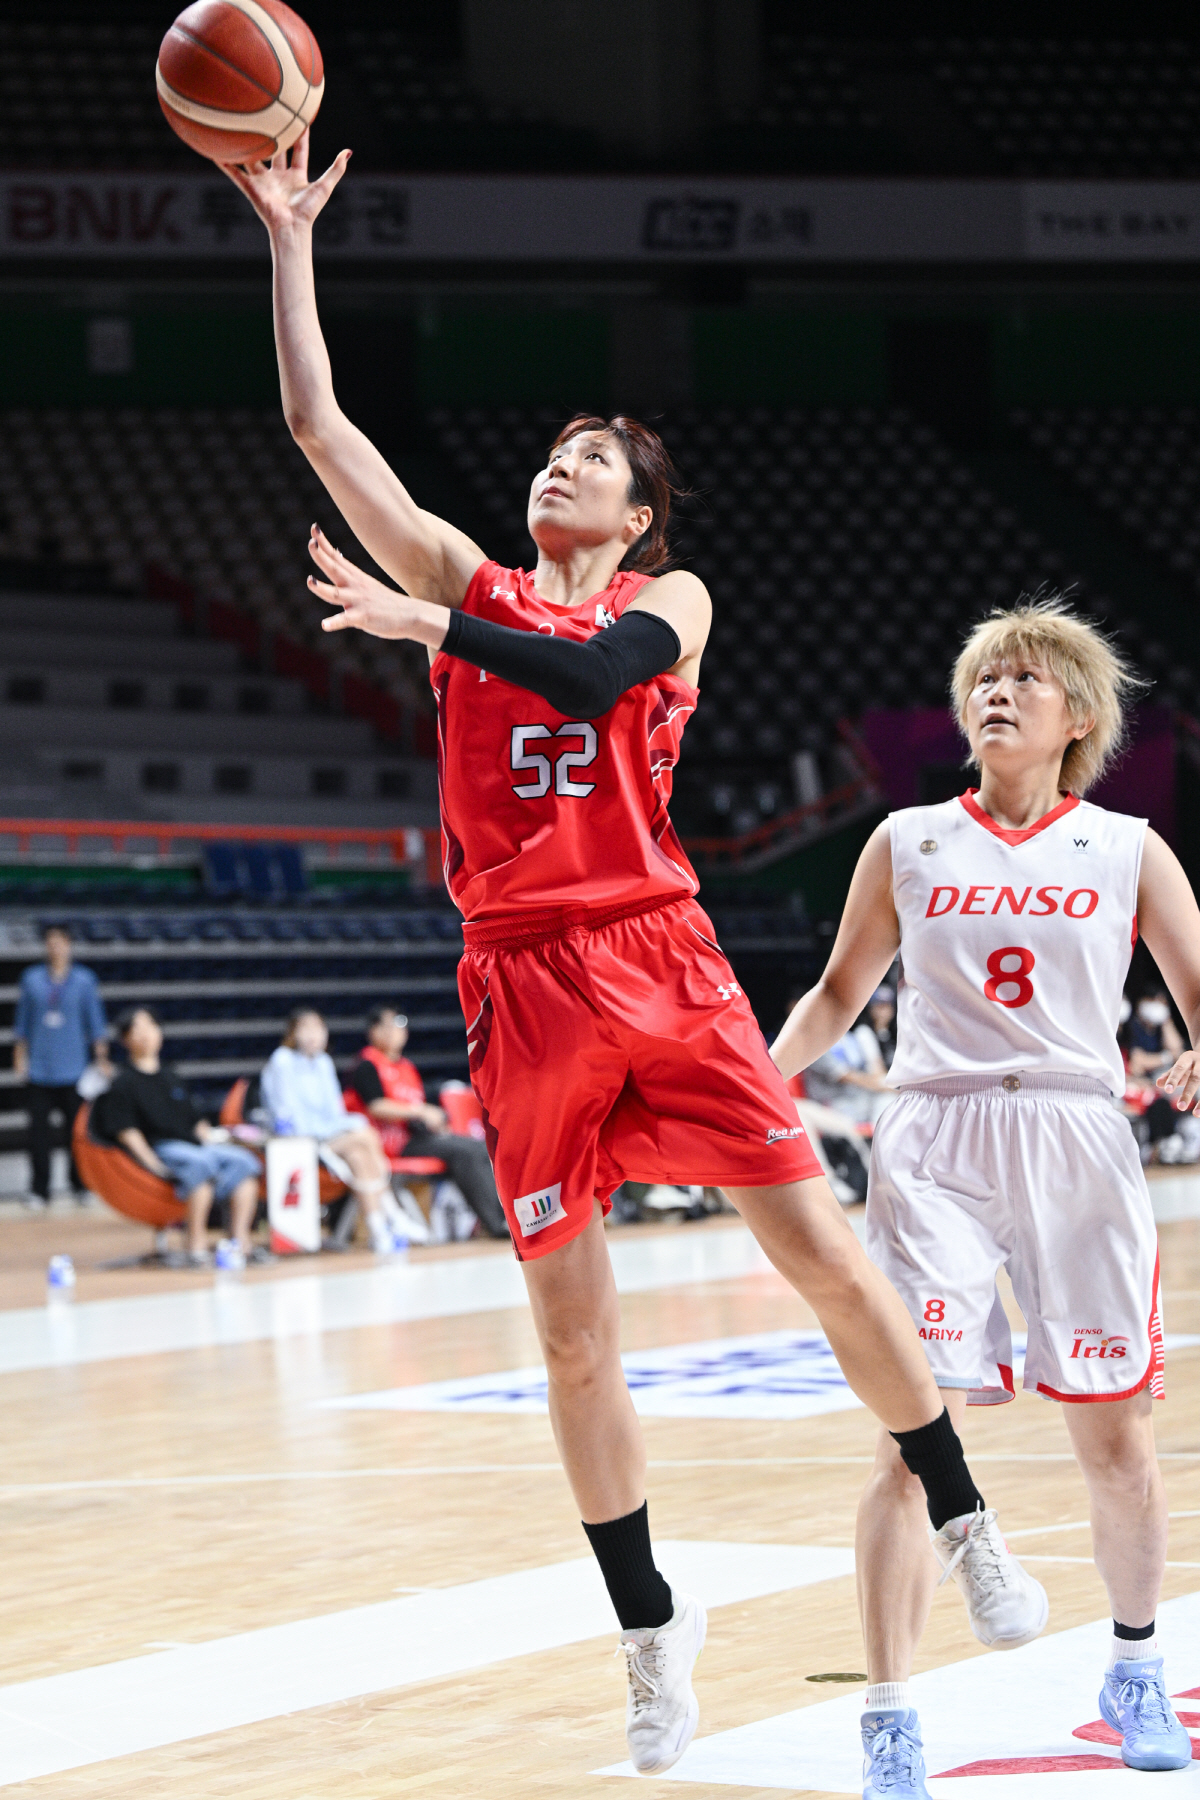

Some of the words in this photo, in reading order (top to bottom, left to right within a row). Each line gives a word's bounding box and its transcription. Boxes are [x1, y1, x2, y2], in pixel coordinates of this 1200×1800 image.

[8, 186, 183, 243] BNK
[510, 721, 599, 799] 52
[925, 886, 1099, 919] DENSO
[983, 946, 1035, 1009] 8
[766, 1127, 788, 1139] Red
[923, 1299, 946, 1323] 8
[918, 1327, 963, 1342] ARIYA
[1068, 1338, 1127, 1359] Iris
